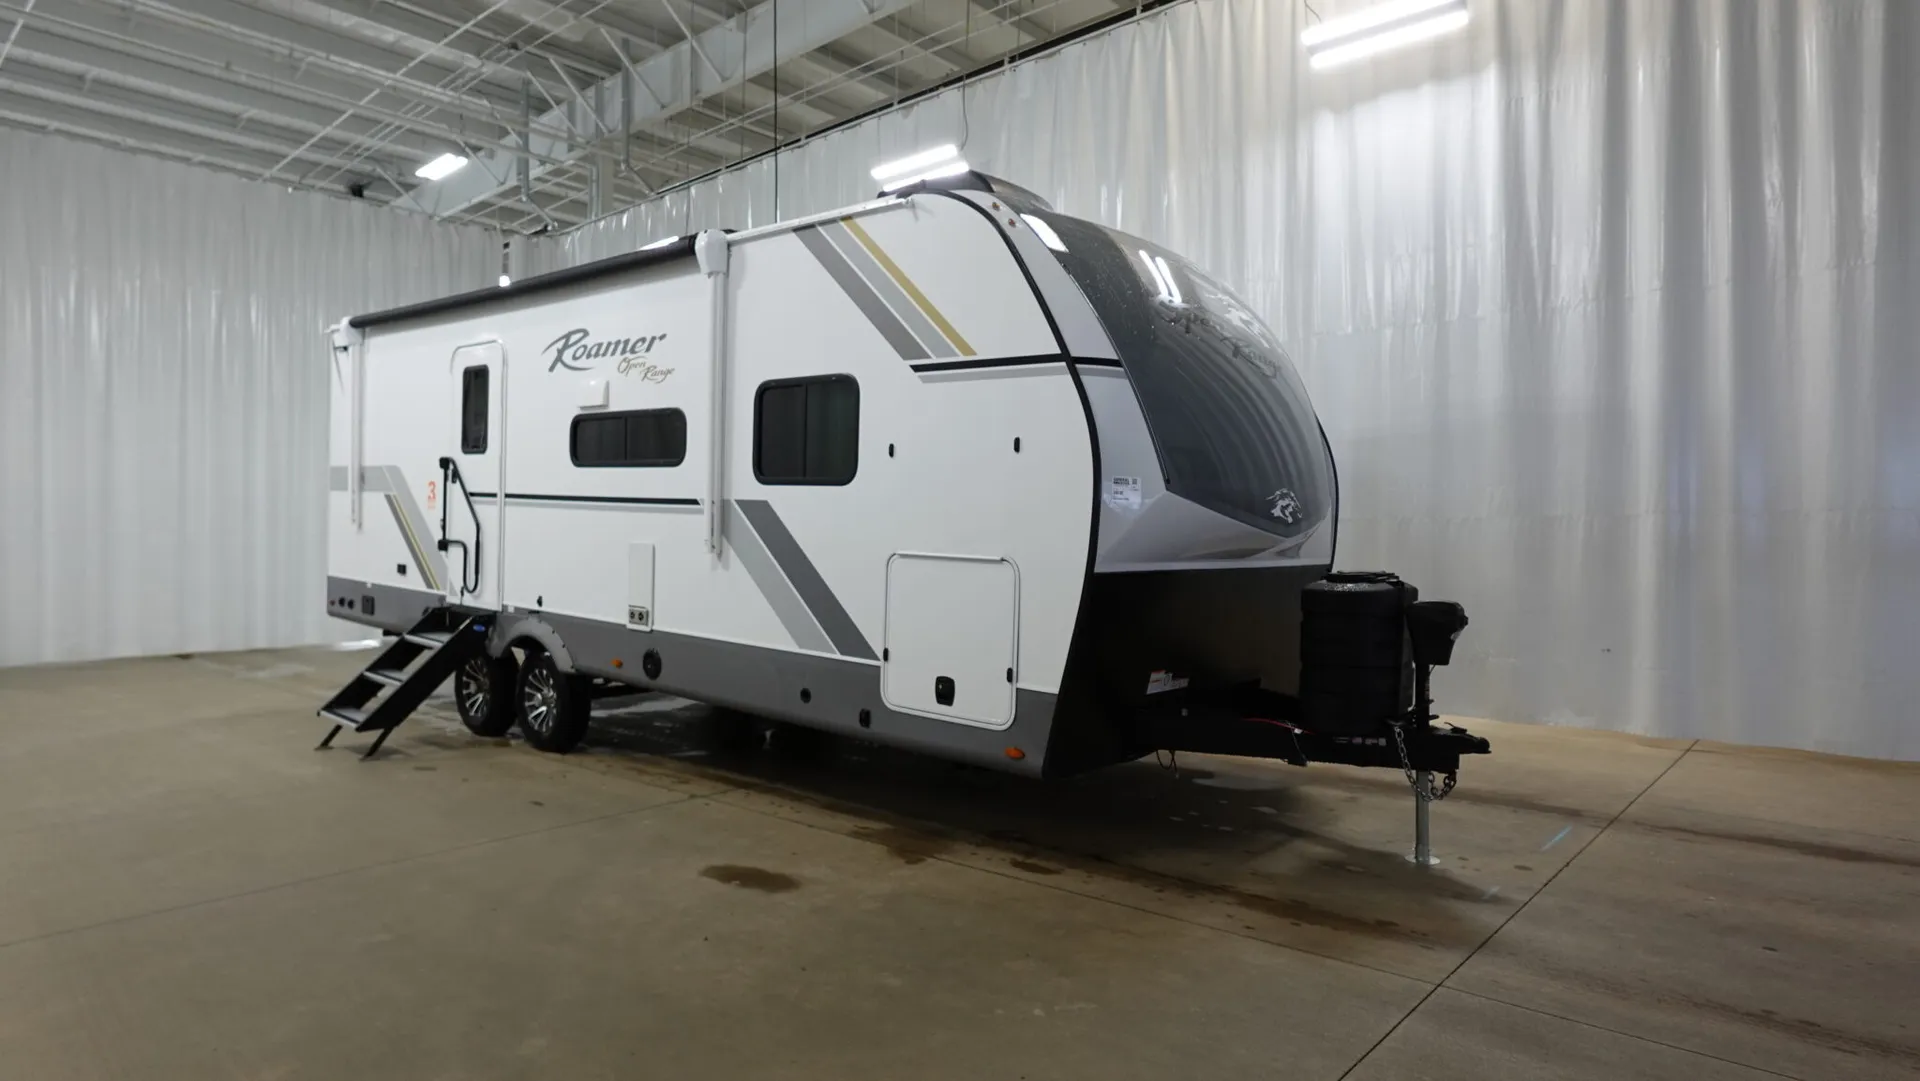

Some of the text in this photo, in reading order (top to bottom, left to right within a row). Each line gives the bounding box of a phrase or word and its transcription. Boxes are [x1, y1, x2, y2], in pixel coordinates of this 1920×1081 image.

[541, 328, 667, 373] Roamer
[617, 356, 675, 384] Open Range
